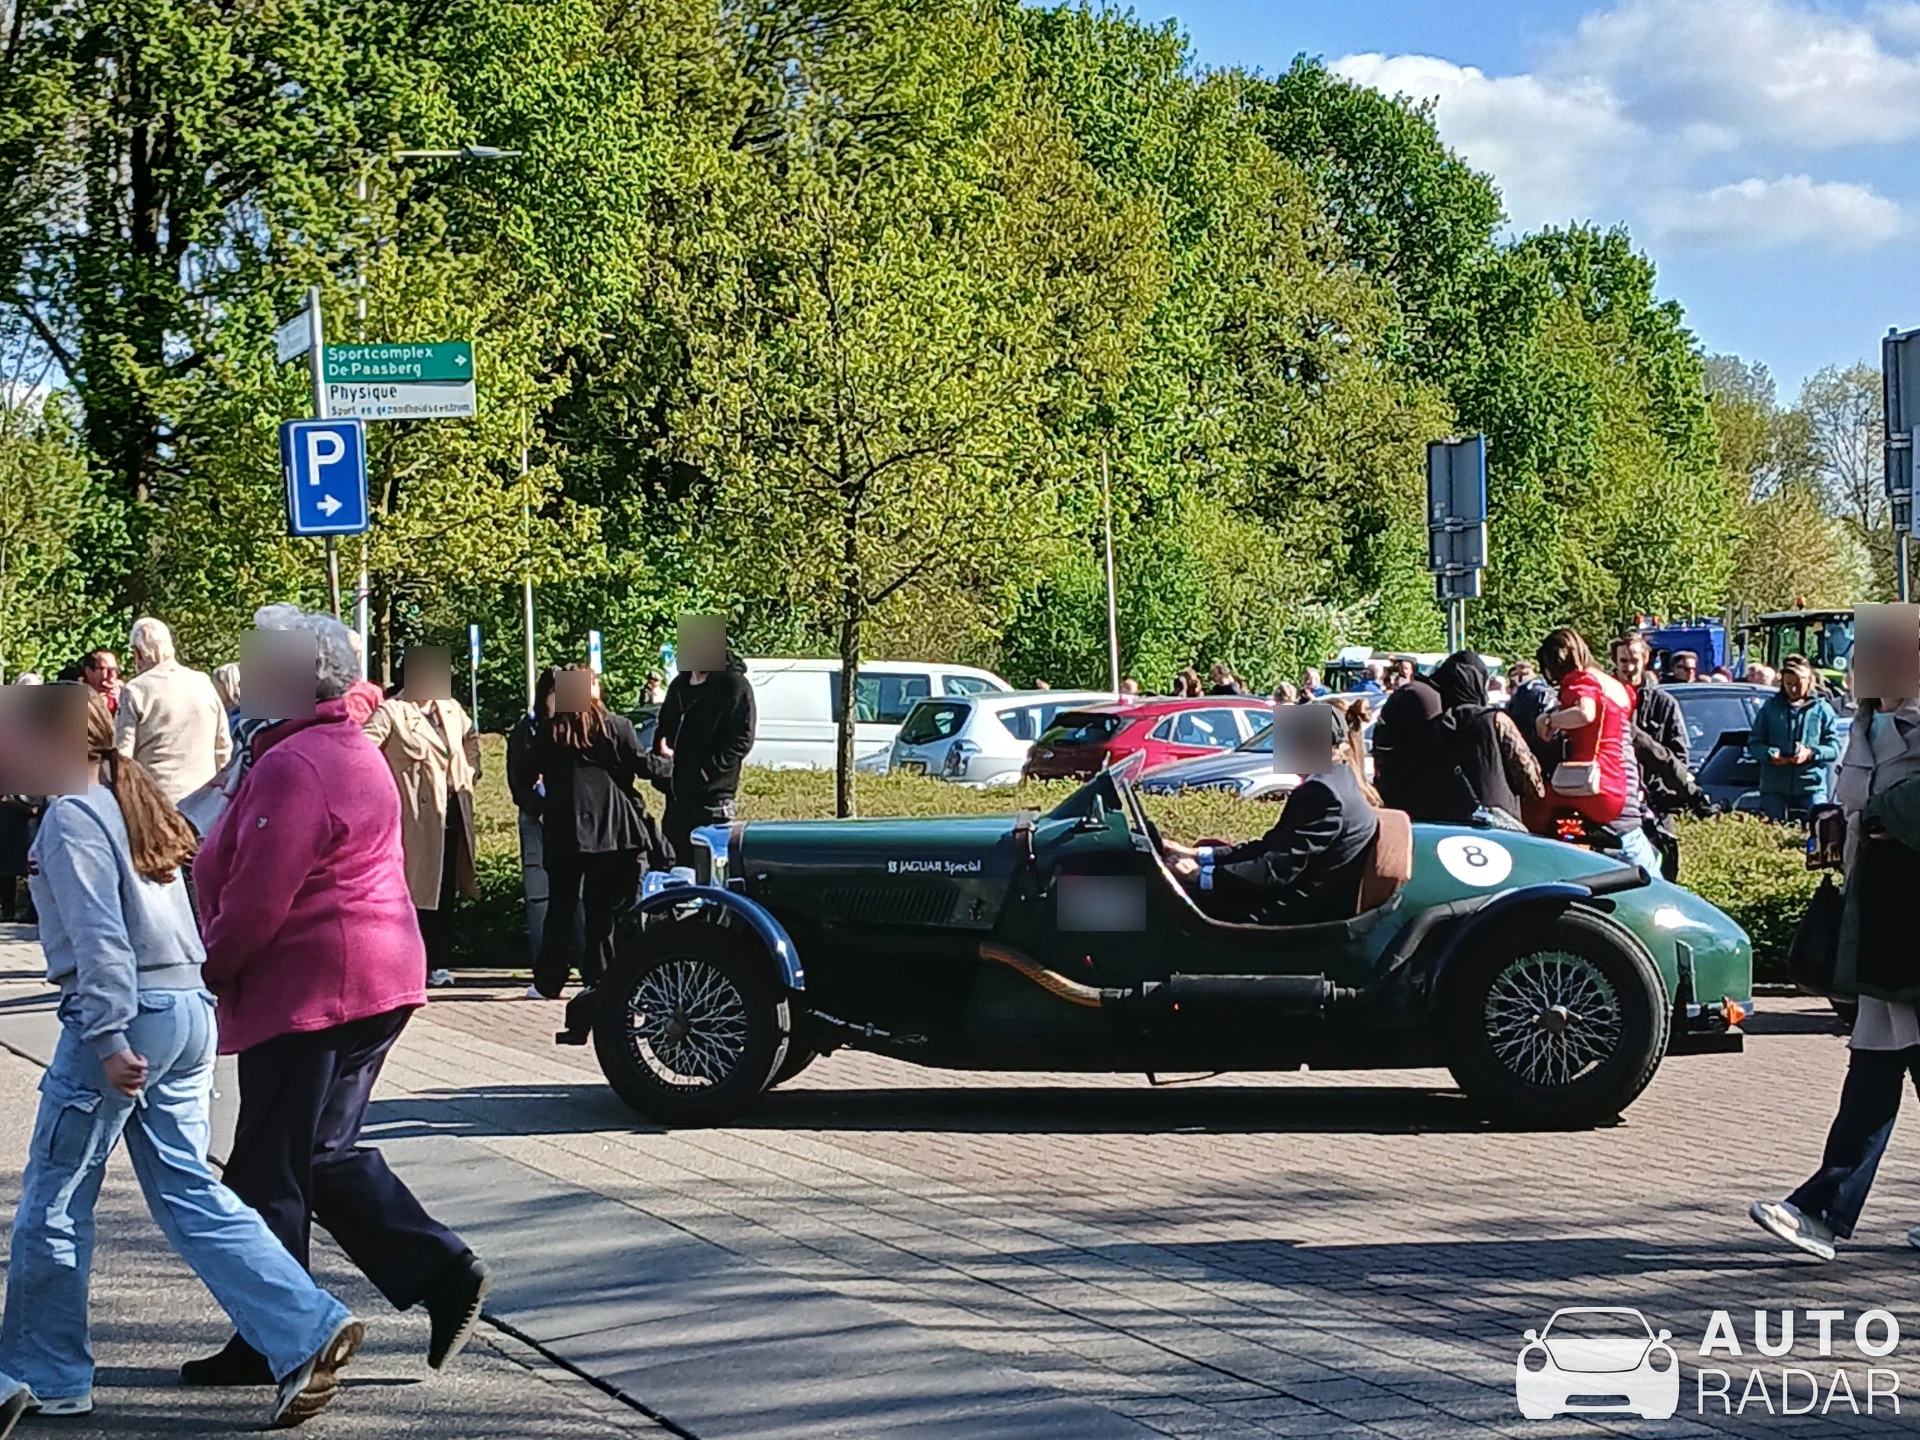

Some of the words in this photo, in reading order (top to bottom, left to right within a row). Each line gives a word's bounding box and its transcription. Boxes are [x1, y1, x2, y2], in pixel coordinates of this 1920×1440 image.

[328, 346, 434, 363] Sportcomplex
[328, 363, 349, 377] De
[351, 362, 422, 378] Paasberg
[330, 383, 398, 403] Physique
[306, 430, 346, 487] P
[1462, 845, 1489, 867] 8
[899, 860, 942, 874] JAGUAR
